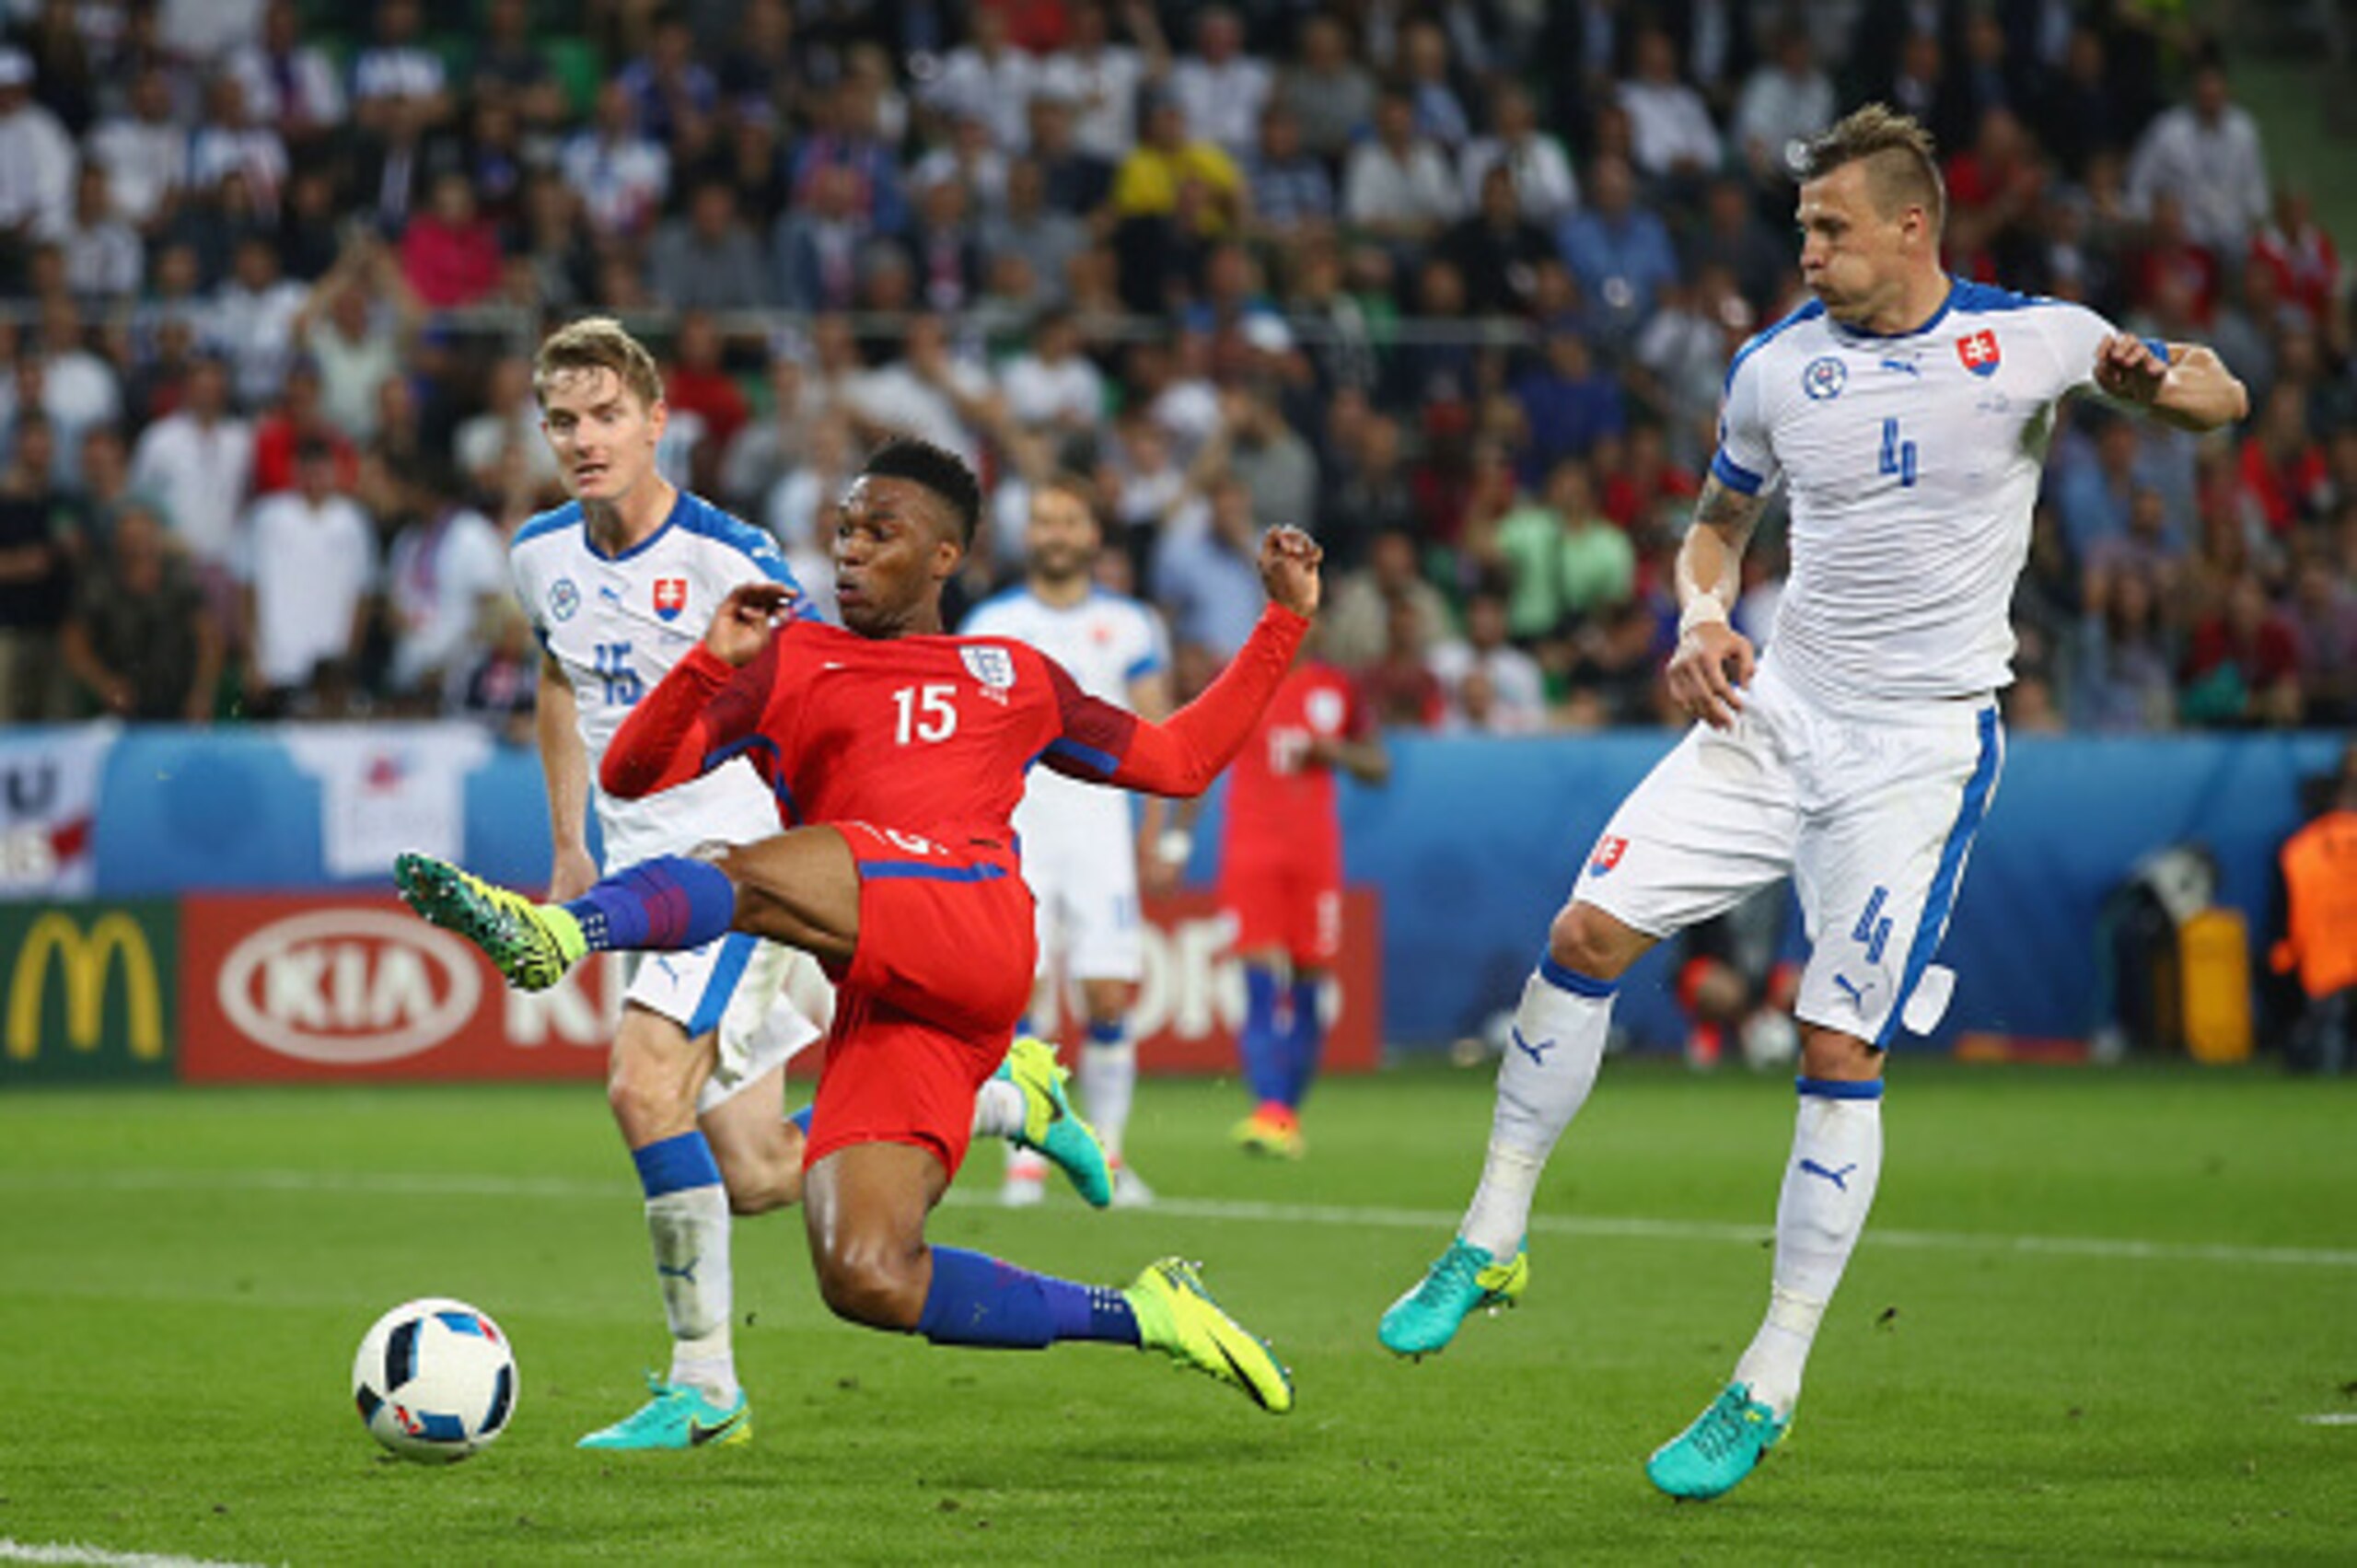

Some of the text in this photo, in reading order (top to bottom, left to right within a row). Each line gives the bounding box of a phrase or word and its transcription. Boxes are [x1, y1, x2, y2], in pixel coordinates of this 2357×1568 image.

[1879, 417, 1917, 486] 4
[593, 639, 644, 706] 15
[891, 683, 958, 744] 15
[1851, 885, 1893, 964] 4
[263, 941, 435, 1029] KIA
